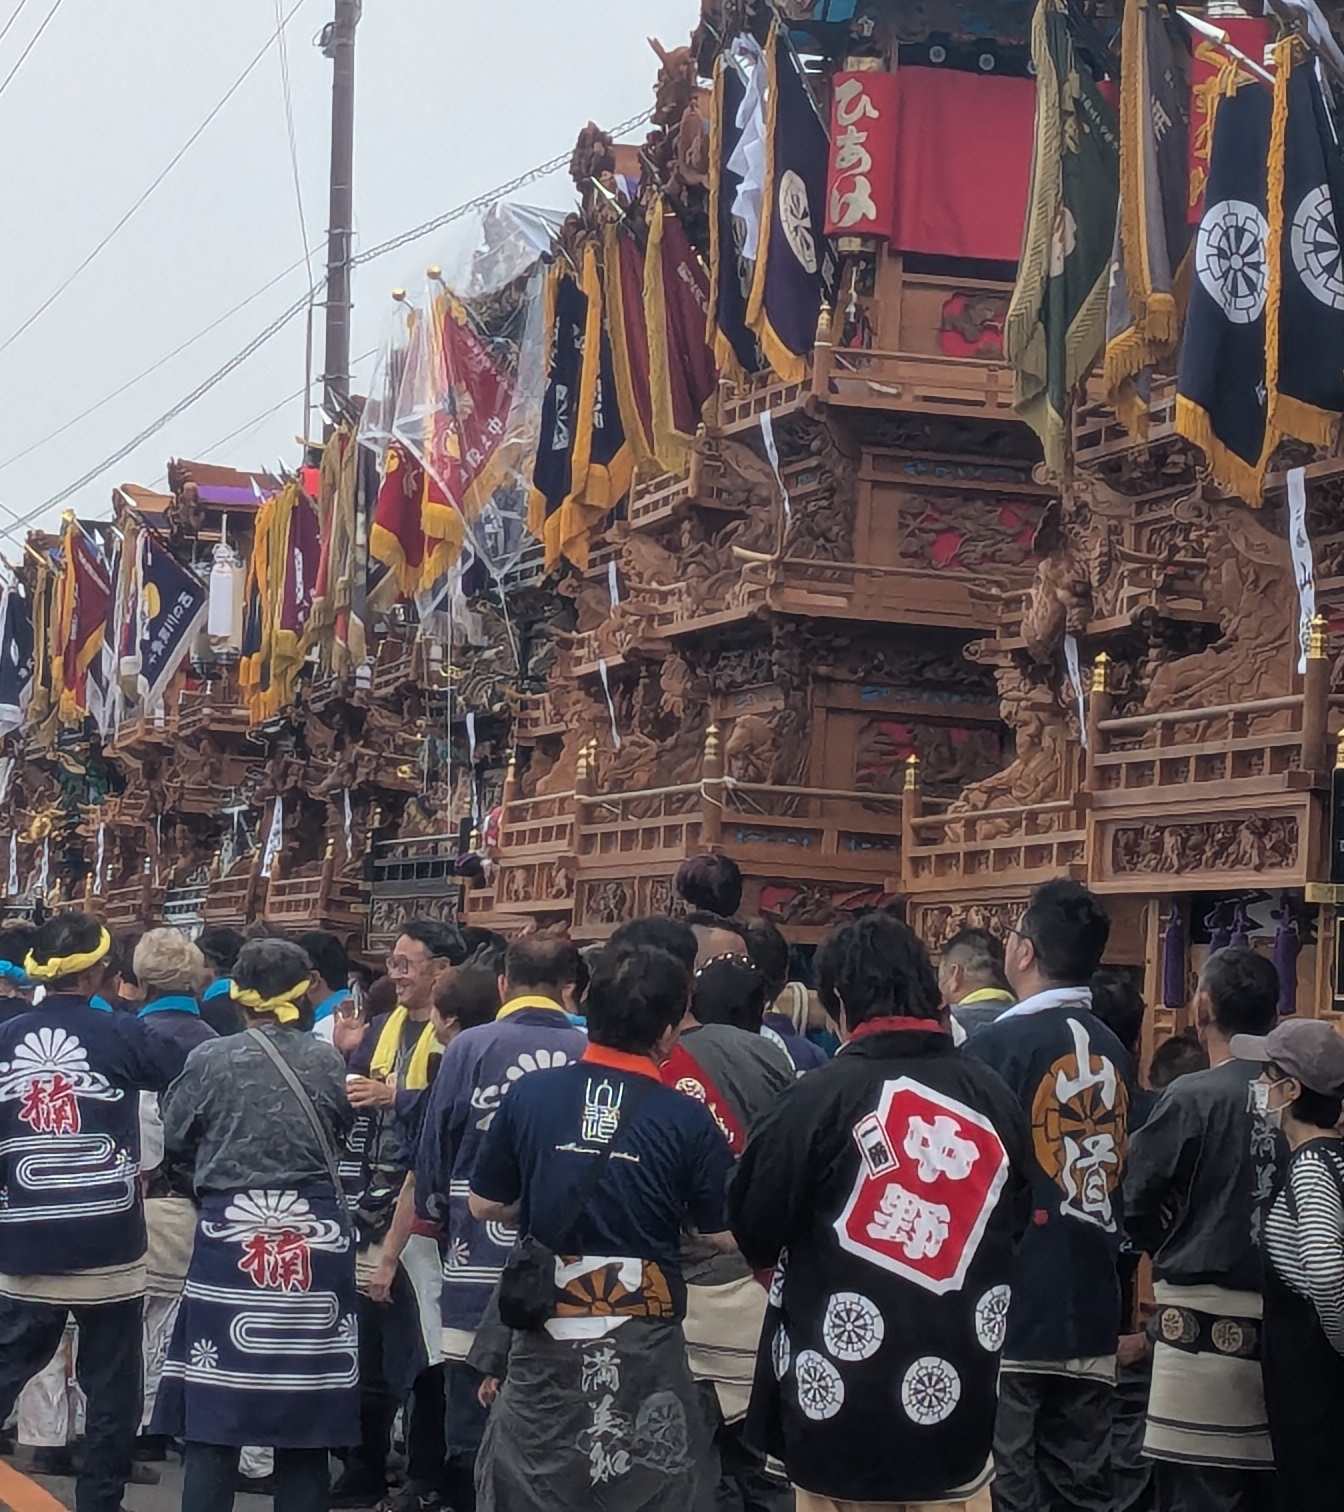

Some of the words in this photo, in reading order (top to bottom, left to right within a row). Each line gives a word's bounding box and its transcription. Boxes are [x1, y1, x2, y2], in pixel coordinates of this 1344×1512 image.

[829, 77, 881, 229] ひあけ
[864, 1113, 983, 1262] 中野
[1053, 1016, 1120, 1234] 山道
